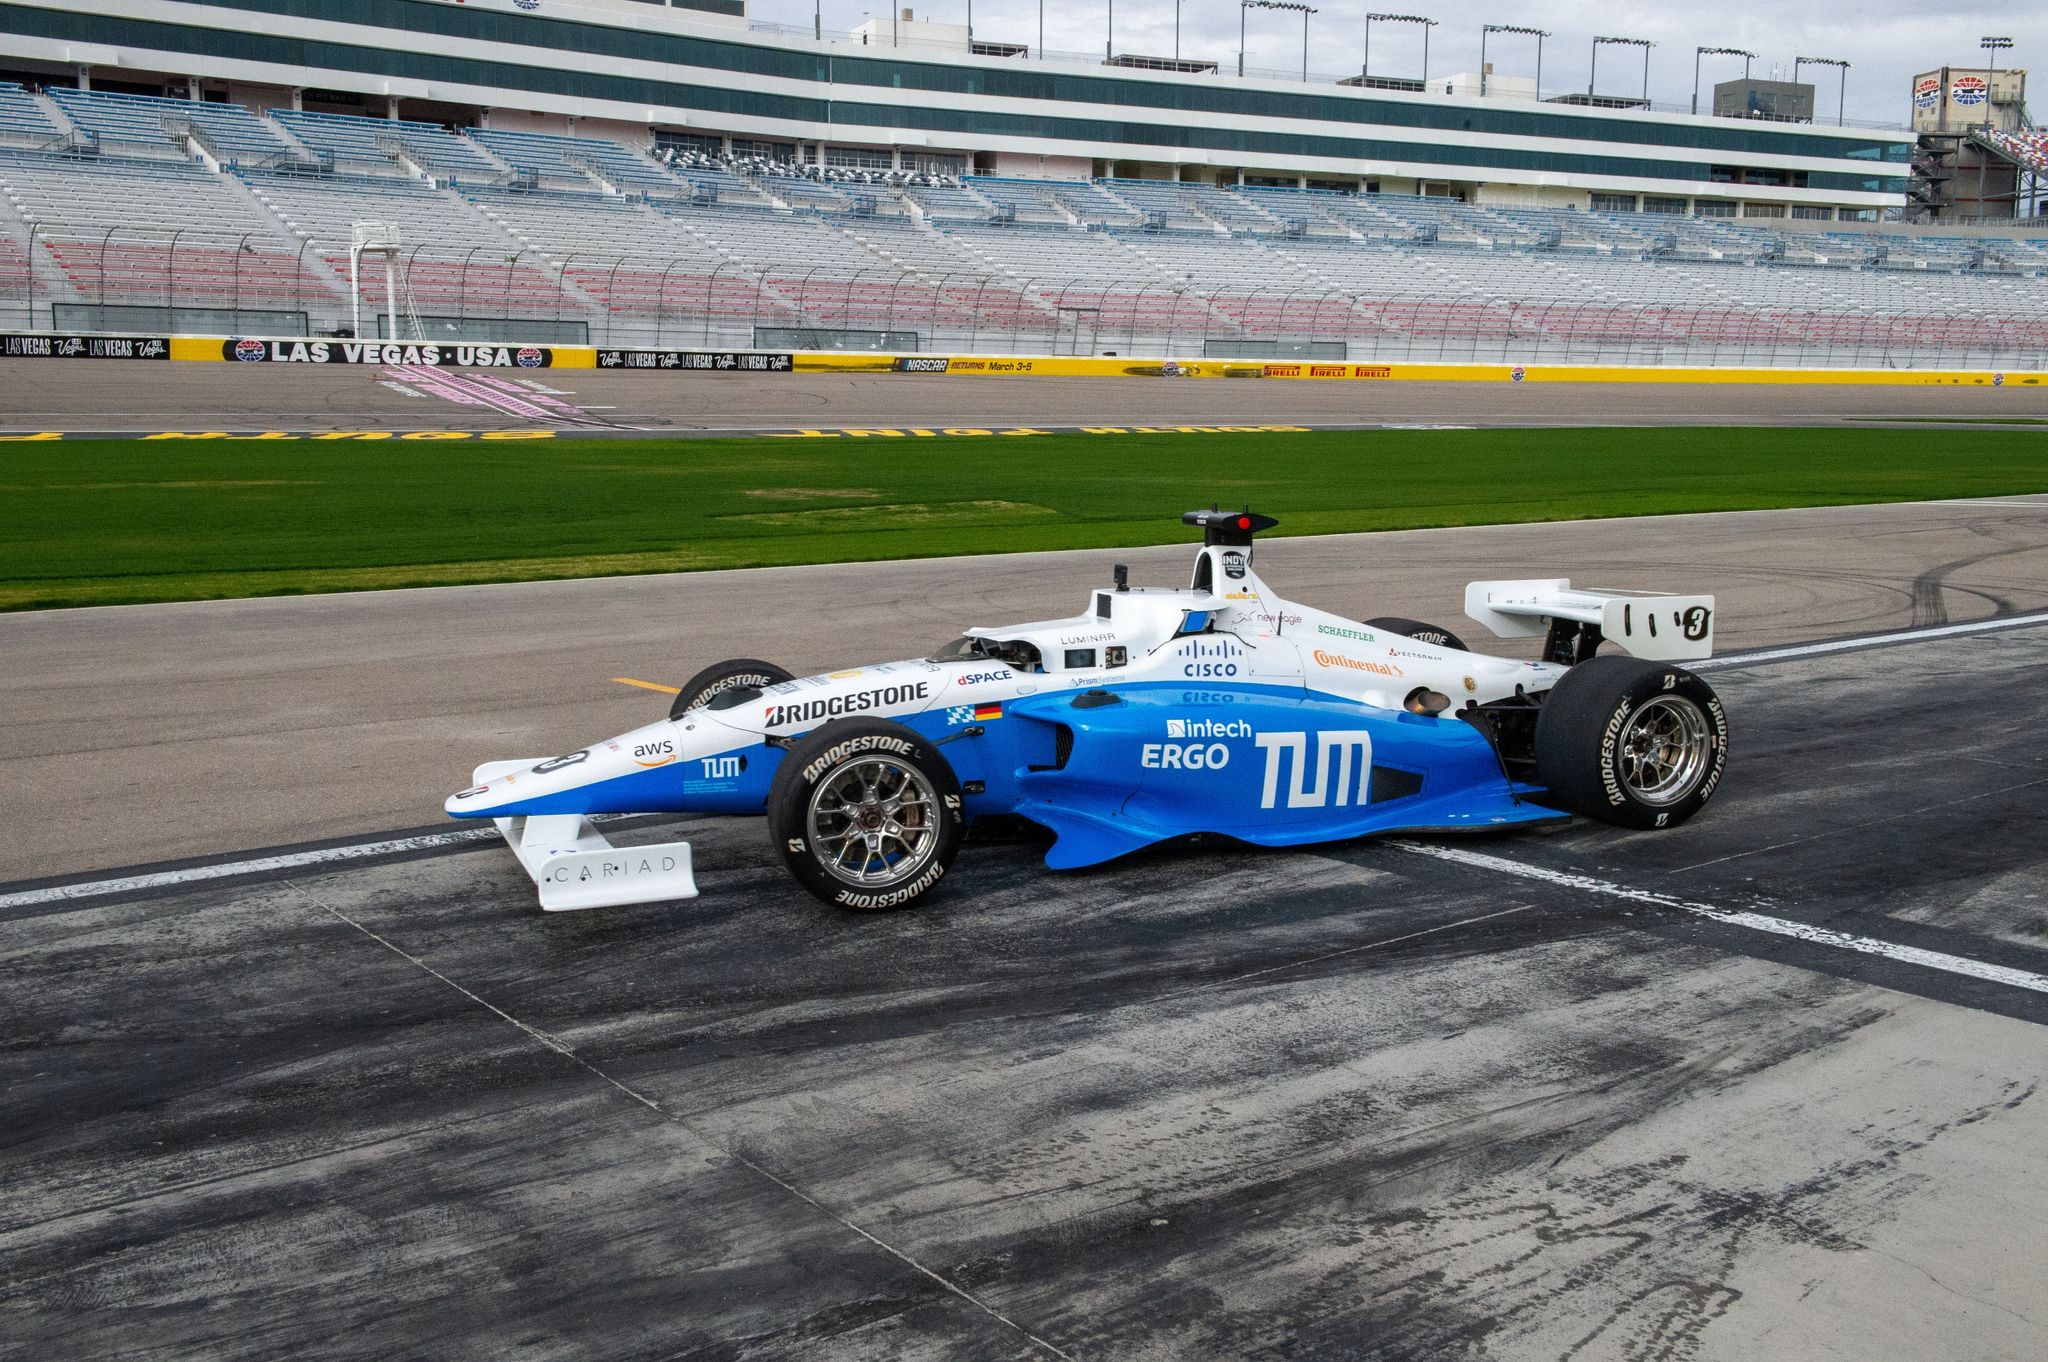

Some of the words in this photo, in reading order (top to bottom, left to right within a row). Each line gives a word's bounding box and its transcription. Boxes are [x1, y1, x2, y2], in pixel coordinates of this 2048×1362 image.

[21, 338, 50, 355] VEGAS
[90, 339, 104, 356] LAS
[105, 340, 132, 357] VEGAS
[271, 341, 330, 363] LAS
[343, 343, 440, 365] VEGAS
[456, 346, 512, 367] USA
[635, 353, 656, 368] VEGAS
[693, 354, 712, 369] VEGAS
[748, 355, 767, 370] VEGAS
[906, 359, 946, 372] NASCAR
[951, 362, 985, 370] RETURNS
[988, 362, 1014, 372] March
[1016, 362, 1032, 371] 3-5
[1310, 366, 1346, 377] PIRELLI
[1355, 367, 1391, 378] PIRELLI
[1222, 555, 1245, 565] INDY
[1258, 613, 1276, 622] new
[1688, 608, 1706, 637] 3
[1061, 633, 1116, 645] LUMINAR
[1317, 624, 1375, 643] SCHAEFFLER
[1184, 664, 1238, 677] CISCO
[1313, 649, 1392, 676] Continental
[957, 670, 1013, 686] dSPACE
[764, 682, 928, 728] BRIDGESTONE
[1186, 719, 1251, 738] intech
[634, 740, 673, 757] aws
[1141, 743, 1230, 769] ERGO
[1600, 700, 1630, 807] BRIDGESTONE
[1700, 697, 1727, 802] BRIDGESTONE
[701, 757, 739, 778] TUM
[803, 736, 914, 784] BRIDGESTONE
[1255, 730, 1373, 809] TUM
[555, 857, 676, 882] CARIAD
[835, 860, 944, 909] BRIDGESTONE
